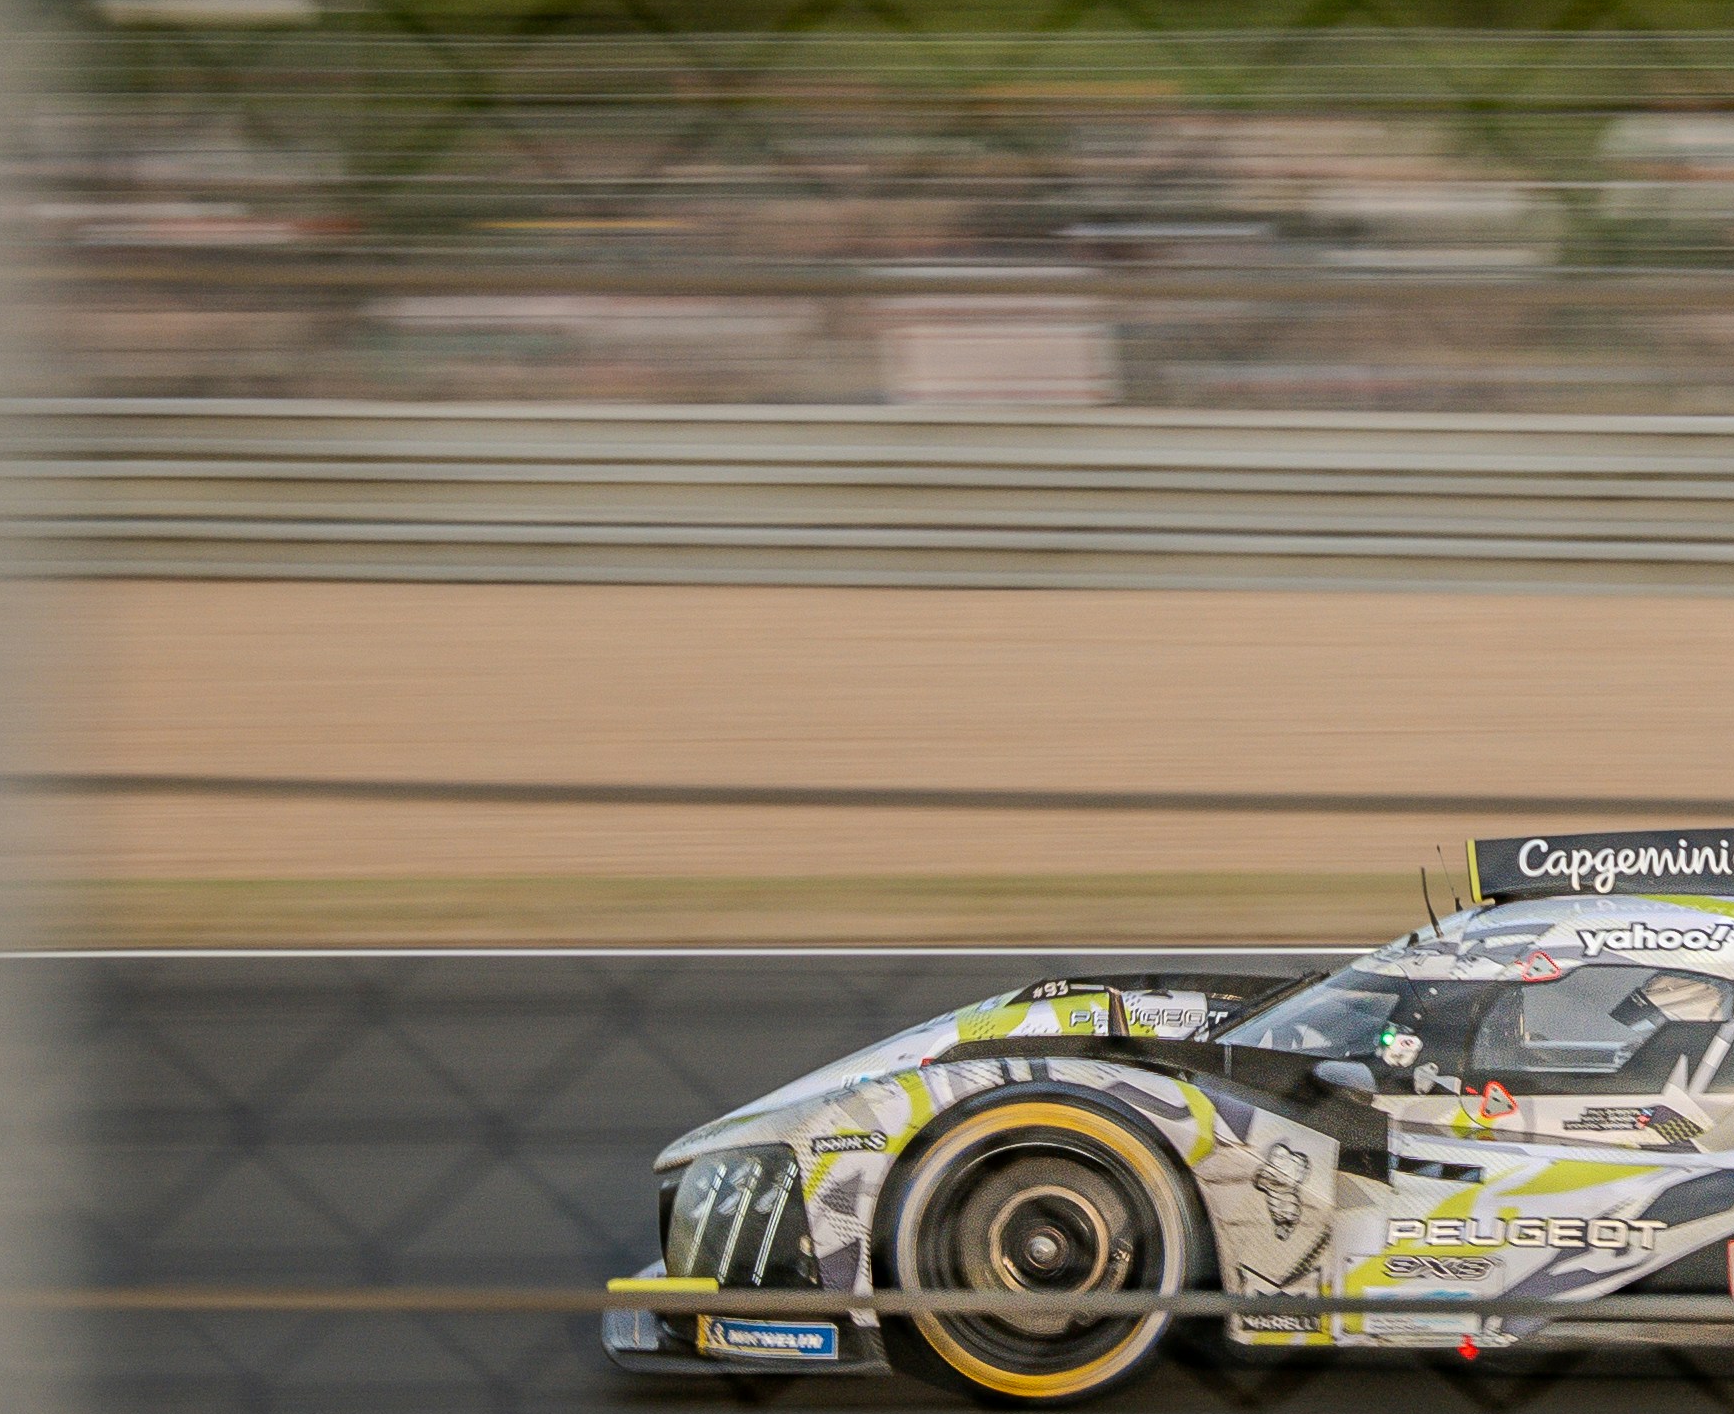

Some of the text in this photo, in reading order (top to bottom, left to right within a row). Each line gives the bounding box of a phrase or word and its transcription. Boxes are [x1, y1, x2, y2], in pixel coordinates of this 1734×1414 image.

[1518, 837, 1734, 894] Capgemini
[1032, 980, 1070, 999] #93
[1385, 1216, 1668, 1250] PEUGEOT
